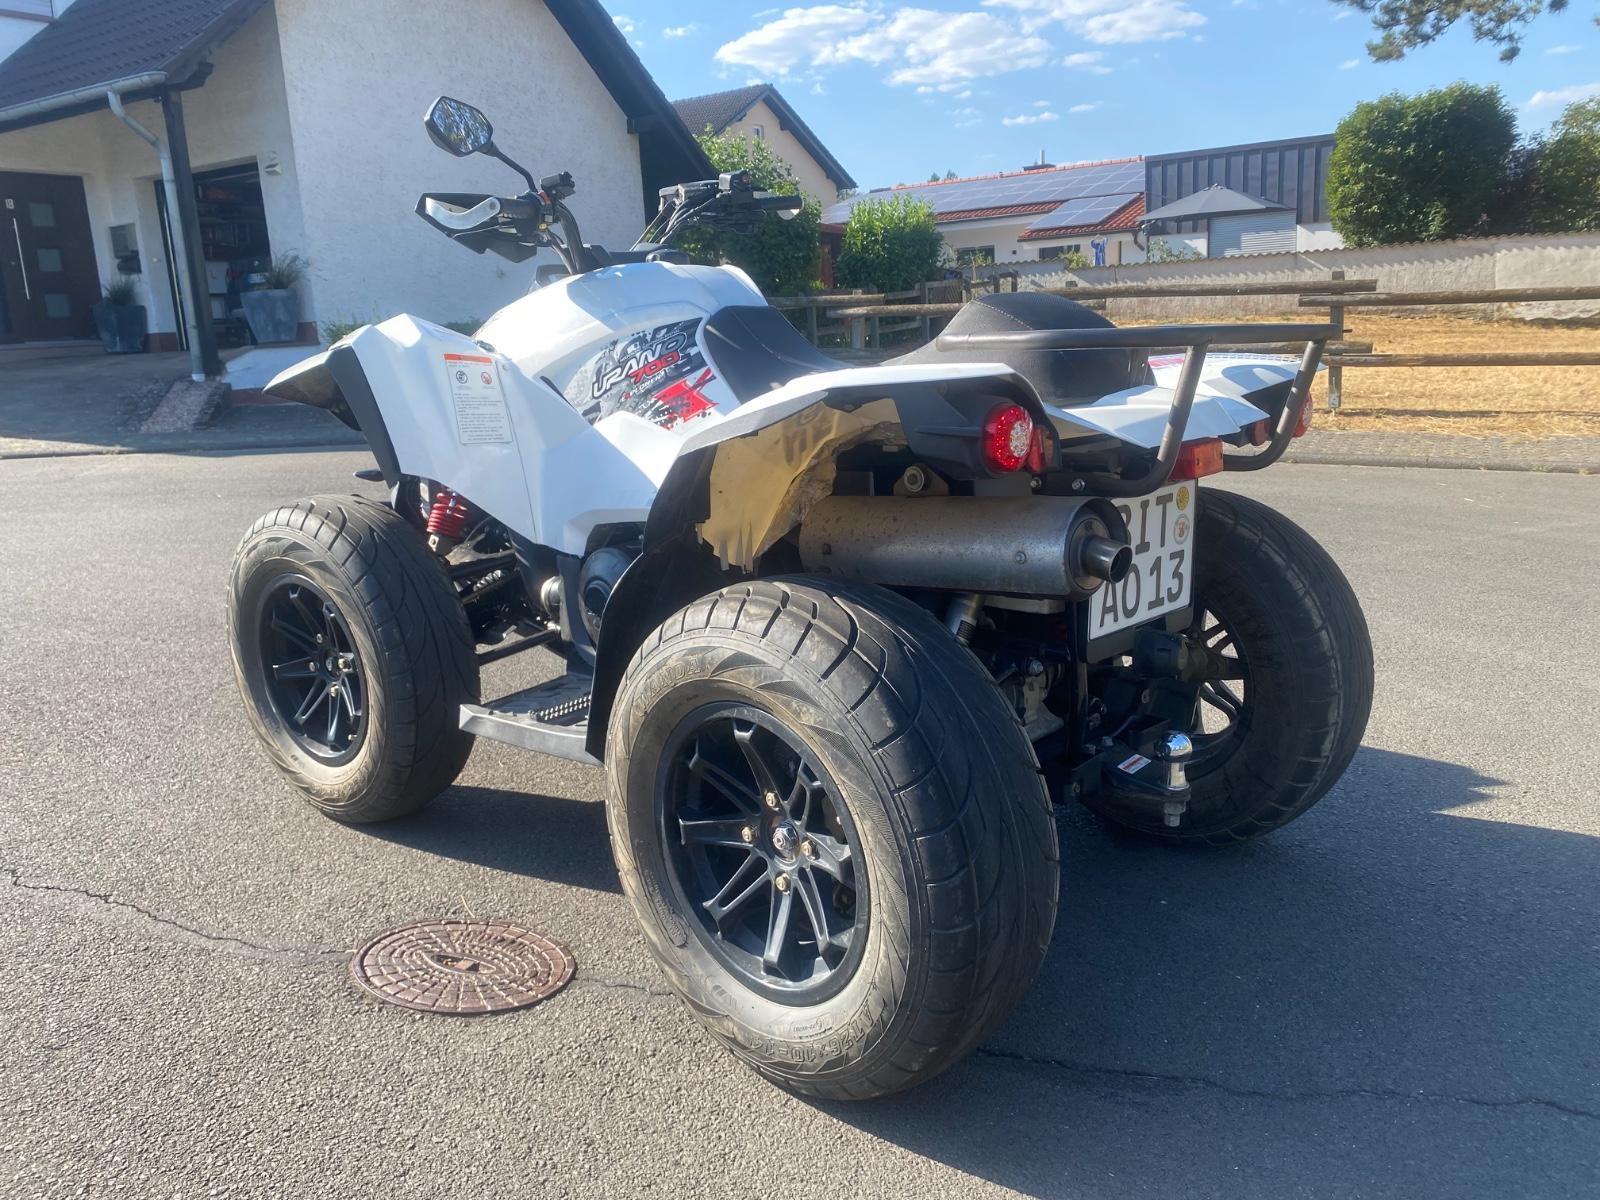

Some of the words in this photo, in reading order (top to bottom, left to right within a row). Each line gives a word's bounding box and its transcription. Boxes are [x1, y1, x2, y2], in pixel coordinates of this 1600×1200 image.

[592, 332, 687, 399] URANO
[628, 350, 681, 384] 700
[1148, 549, 1185, 611] 13
